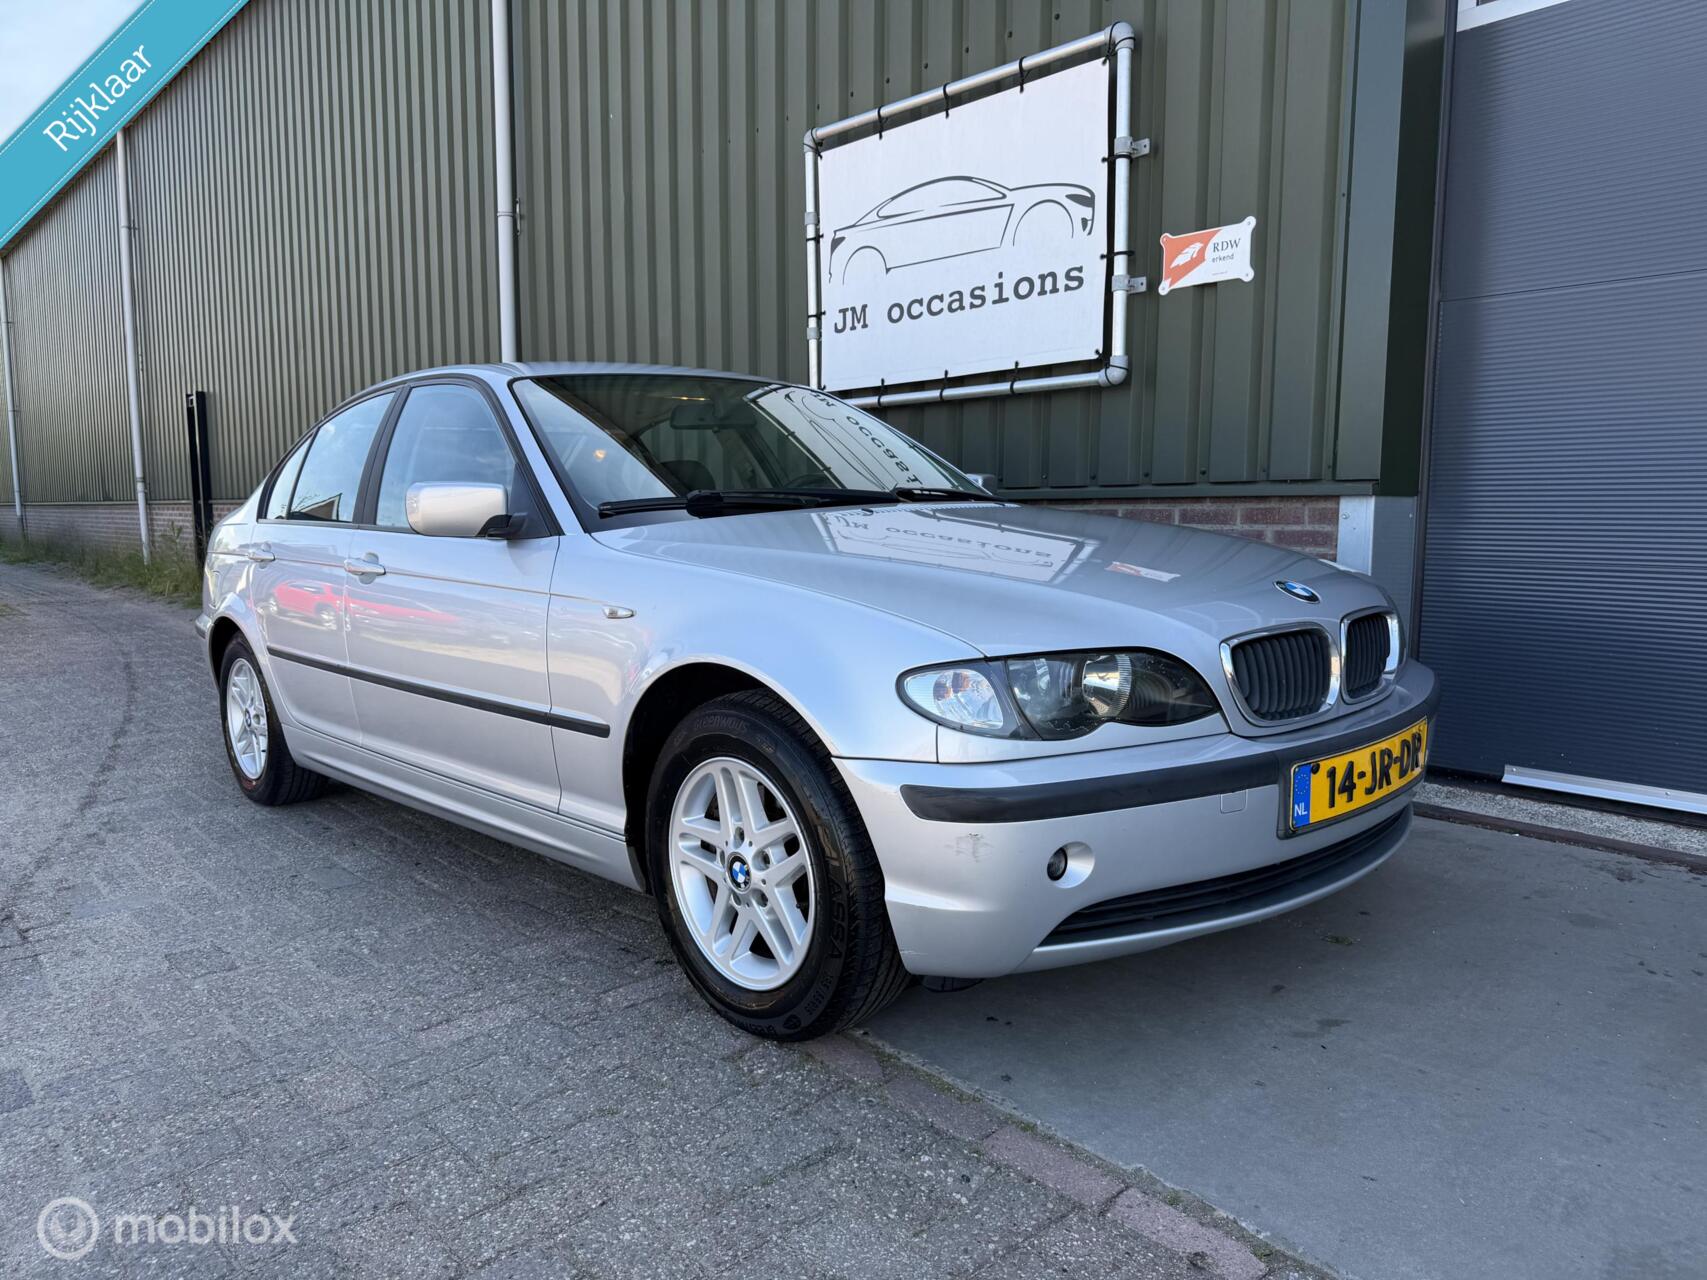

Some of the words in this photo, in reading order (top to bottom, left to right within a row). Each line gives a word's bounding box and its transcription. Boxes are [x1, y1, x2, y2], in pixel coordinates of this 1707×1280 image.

[1213, 237, 1241, 253] RDW
[1212, 252, 1235, 263] erkend
[834, 304, 869, 334] JM
[887, 265, 1085, 324] occasions
[1294, 802, 1308, 817] NL
